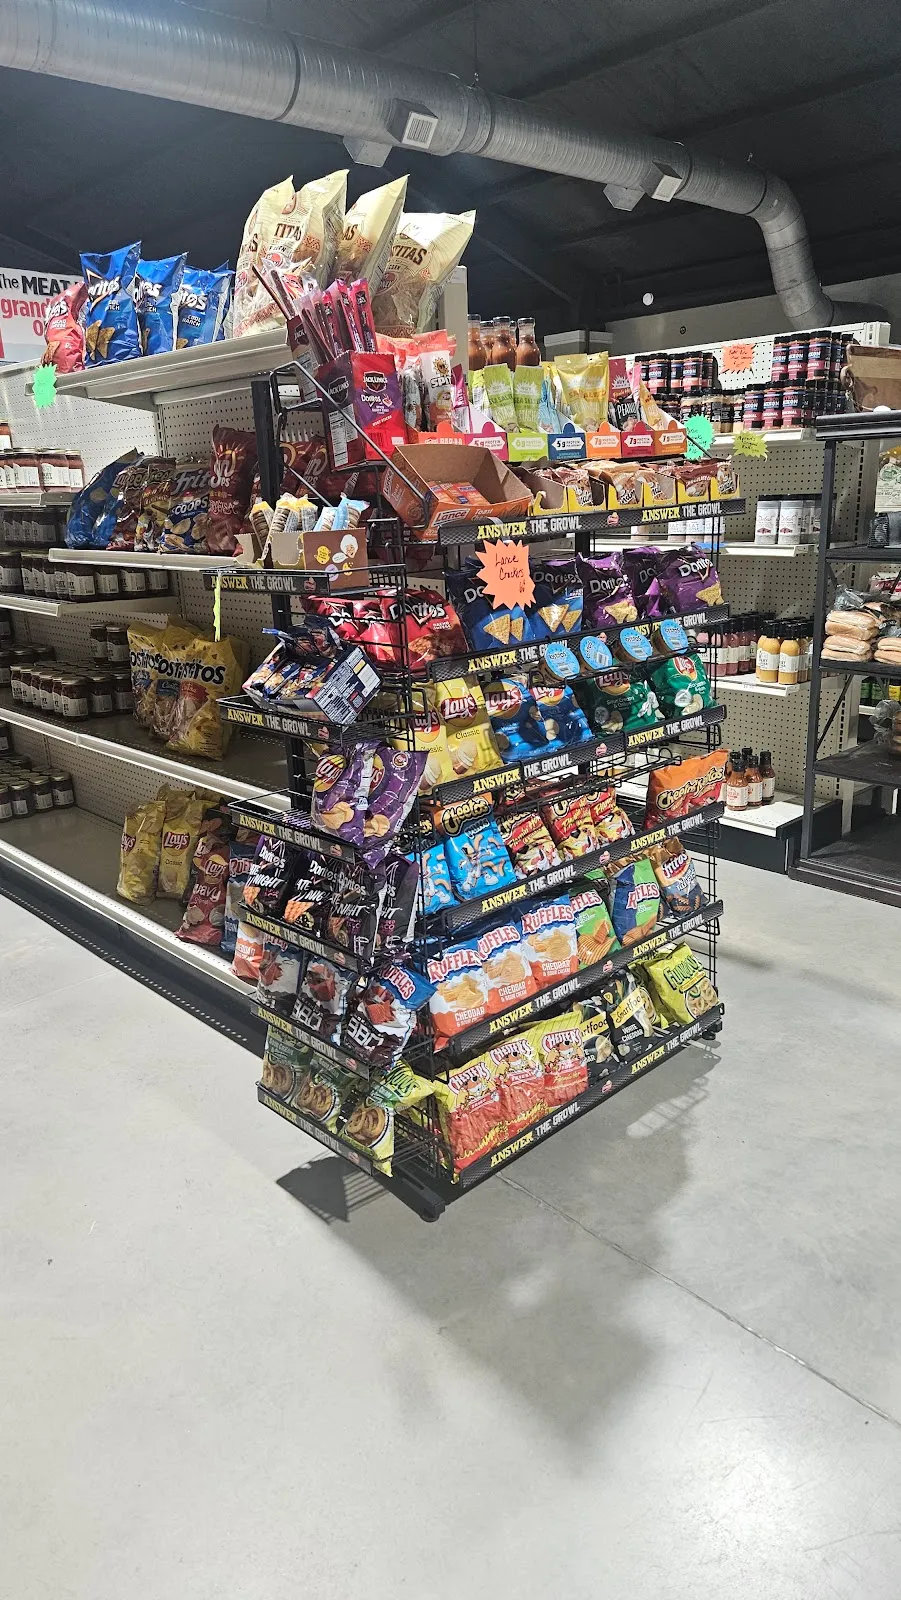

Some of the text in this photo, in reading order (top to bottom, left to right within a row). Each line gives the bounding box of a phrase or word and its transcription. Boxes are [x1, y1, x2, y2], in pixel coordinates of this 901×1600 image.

[431, 376, 452, 389] SPIT
[172, 469, 210, 495] Frit
[436, 509, 467, 523] Lance
[642, 502, 723, 520] ANSWER THE GROWL
[477, 516, 583, 539] ANSWER THE GROWL
[495, 553, 519, 567] Lance
[211, 576, 297, 591] ASWER THE GROWL
[683, 613, 708, 627] GROWL
[468, 647, 537, 672] ANSWER THE
[443, 695, 476, 720] Lay's
[485, 689, 522, 711] Lay's
[227, 707, 312, 737] ANSWER THE GROWL
[455, 728, 481, 740] Classic
[628, 715, 705, 747] ANSWER THE GROWL
[473, 754, 573, 792] ANSWER THE GROWL
[442, 799, 489, 836] Cheetos
[121, 834, 136, 854] ay's
[164, 832, 190, 850] Lay's
[240, 814, 323, 851] ANSWER THE GROWL
[631, 813, 705, 851] ANSWER THE GROWL
[663, 853, 689, 878] Fritos
[481, 883, 528, 912] ANSWER
[529, 878, 545, 892] THE
[545, 865, 577, 888] GROWL
[522, 904, 575, 934] RUFFLES
[245, 911, 282, 937] ANSWER
[283, 927, 298, 944] THE
[299, 935, 327, 958] GROWL
[632, 914, 705, 958] ANSWER THE GROWL
[427, 949, 483, 982] RUFFLES
[542, 960, 571, 971] CHEDDAR
[498, 982, 526, 997] CHEDDAR
[455, 1007, 485, 1022] CHEDDAR
[489, 978, 581, 1034] ANSWER THE GROWL
[257, 1006, 292, 1034] ANSWER
[295, 1026, 311, 1045] THE
[311, 1035, 339, 1061] GROWL
[543, 1028, 582, 1053] CHESTER'S
[621, 1029, 644, 1042] CHEDDAR
[622, 1023, 638, 1034] WHITE
[491, 1039, 533, 1066] CHESTER'S
[631, 1022, 703, 1075] ANSWER THE GROWL
[448, 1061, 491, 1094] CHESTER'S
[264, 1094, 341, 1154] ANSWER THE GROWL
[490, 1101, 581, 1167] ANSWER THE GROWL
